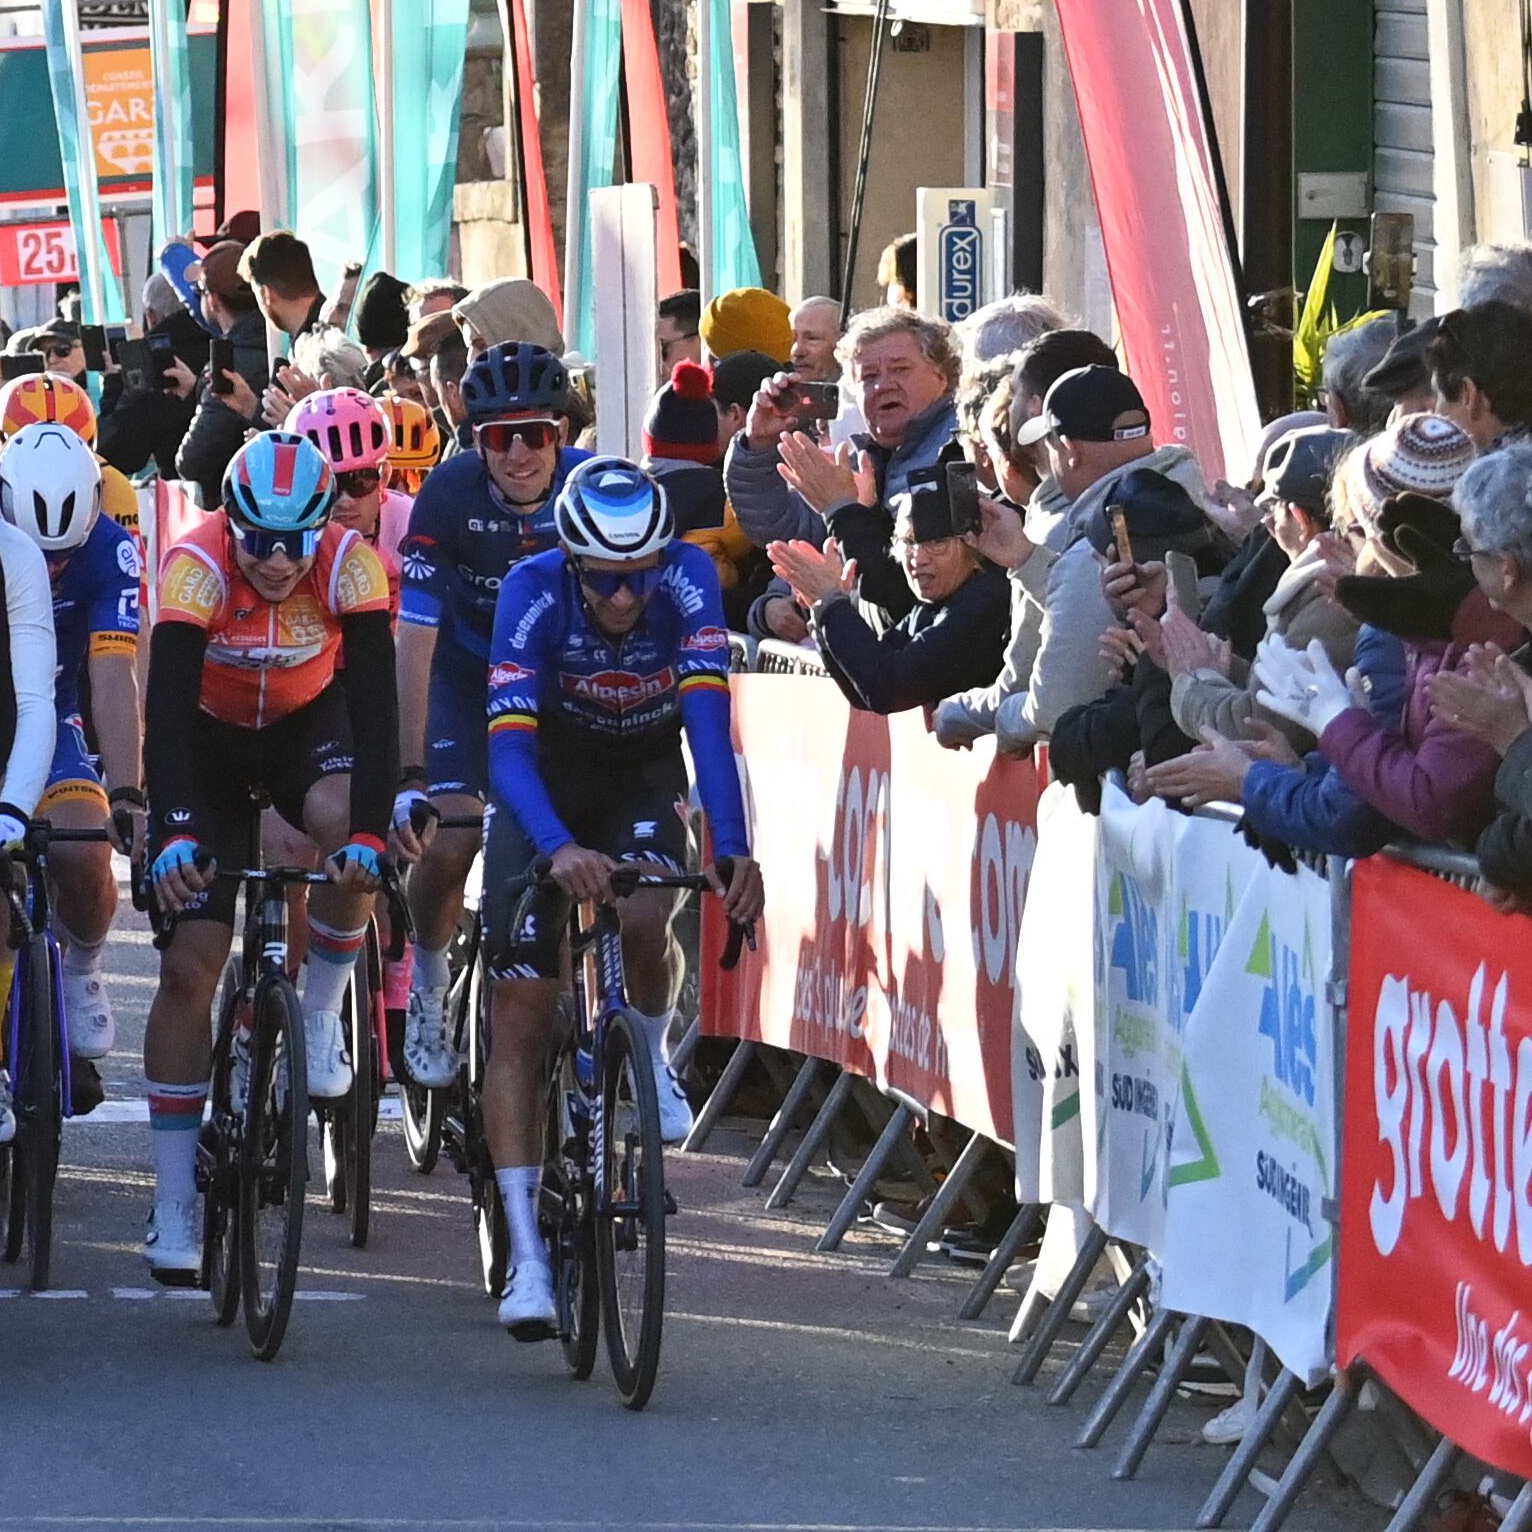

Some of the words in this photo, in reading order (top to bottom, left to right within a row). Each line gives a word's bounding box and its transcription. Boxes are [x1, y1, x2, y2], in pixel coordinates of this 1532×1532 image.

[88, 97, 155, 126] GAR
[22, 229, 65, 277] 25
[944, 230, 979, 320] durex
[177, 567, 204, 604] GARD
[346, 559, 371, 596] GARD
[574, 676, 662, 699] Alpecin
